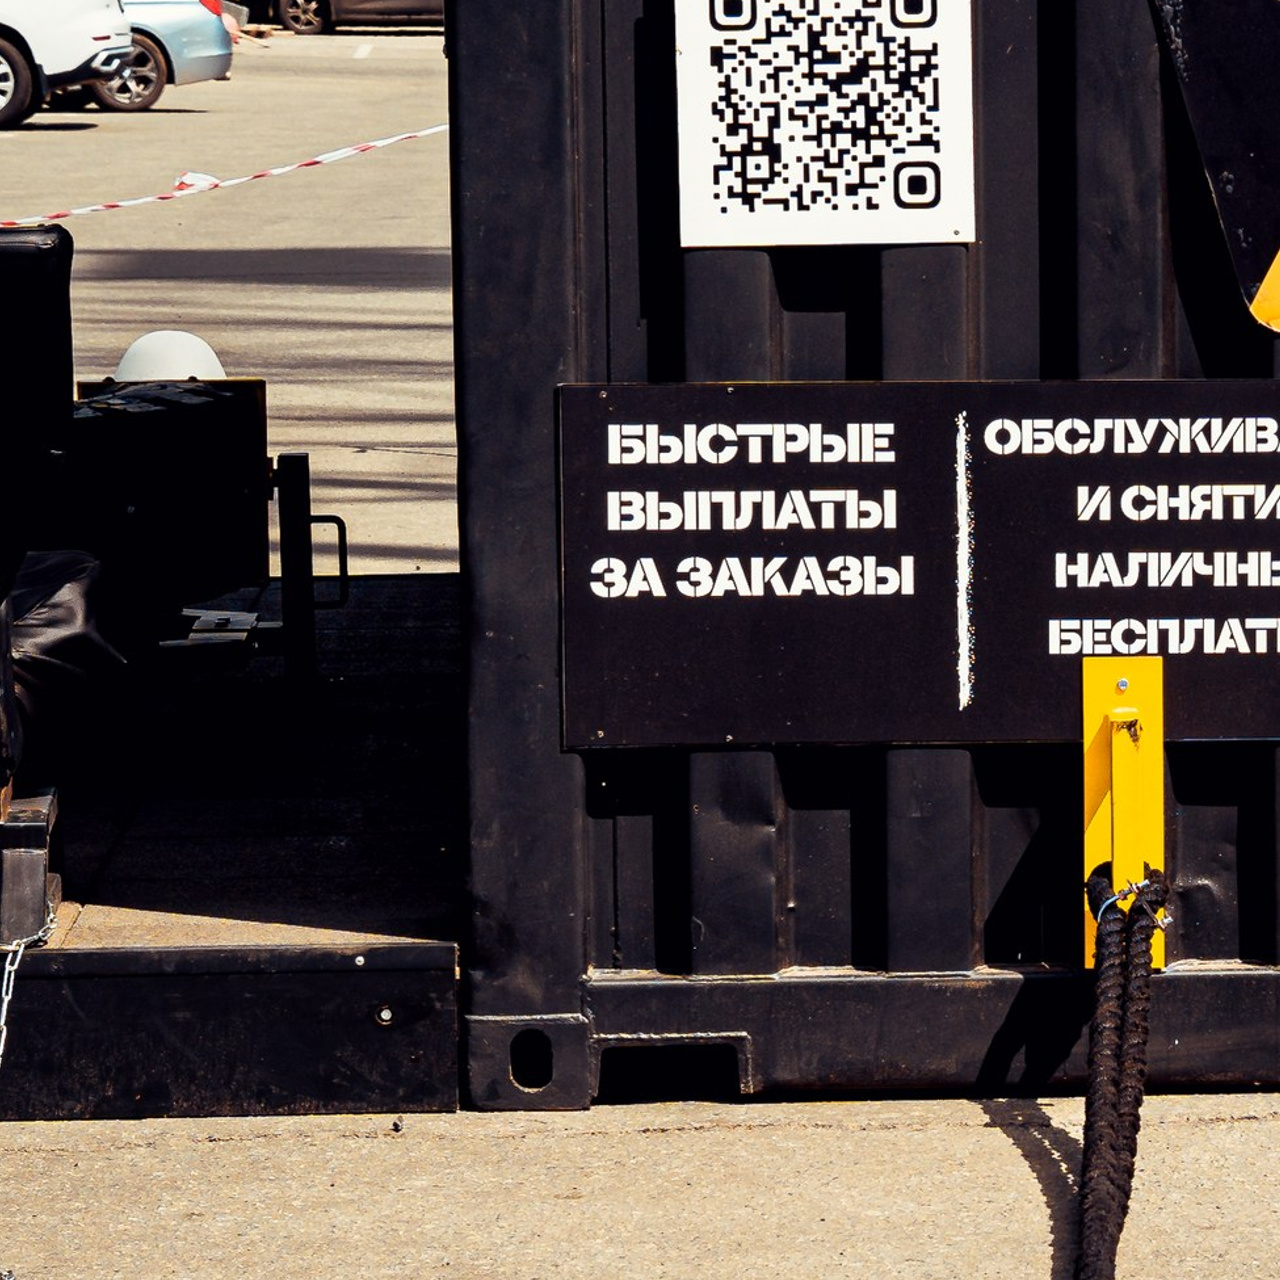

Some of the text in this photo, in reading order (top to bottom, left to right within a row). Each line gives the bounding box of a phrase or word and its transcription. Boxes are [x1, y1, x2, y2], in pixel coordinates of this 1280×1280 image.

[607, 423, 896, 465] БЫСТРЫЕ
[606, 489, 897, 531] ВЫПЛАТЫ
[1077, 485, 1112, 521] И
[590, 555, 915, 598] ЗА ЗАКАЗЫ
